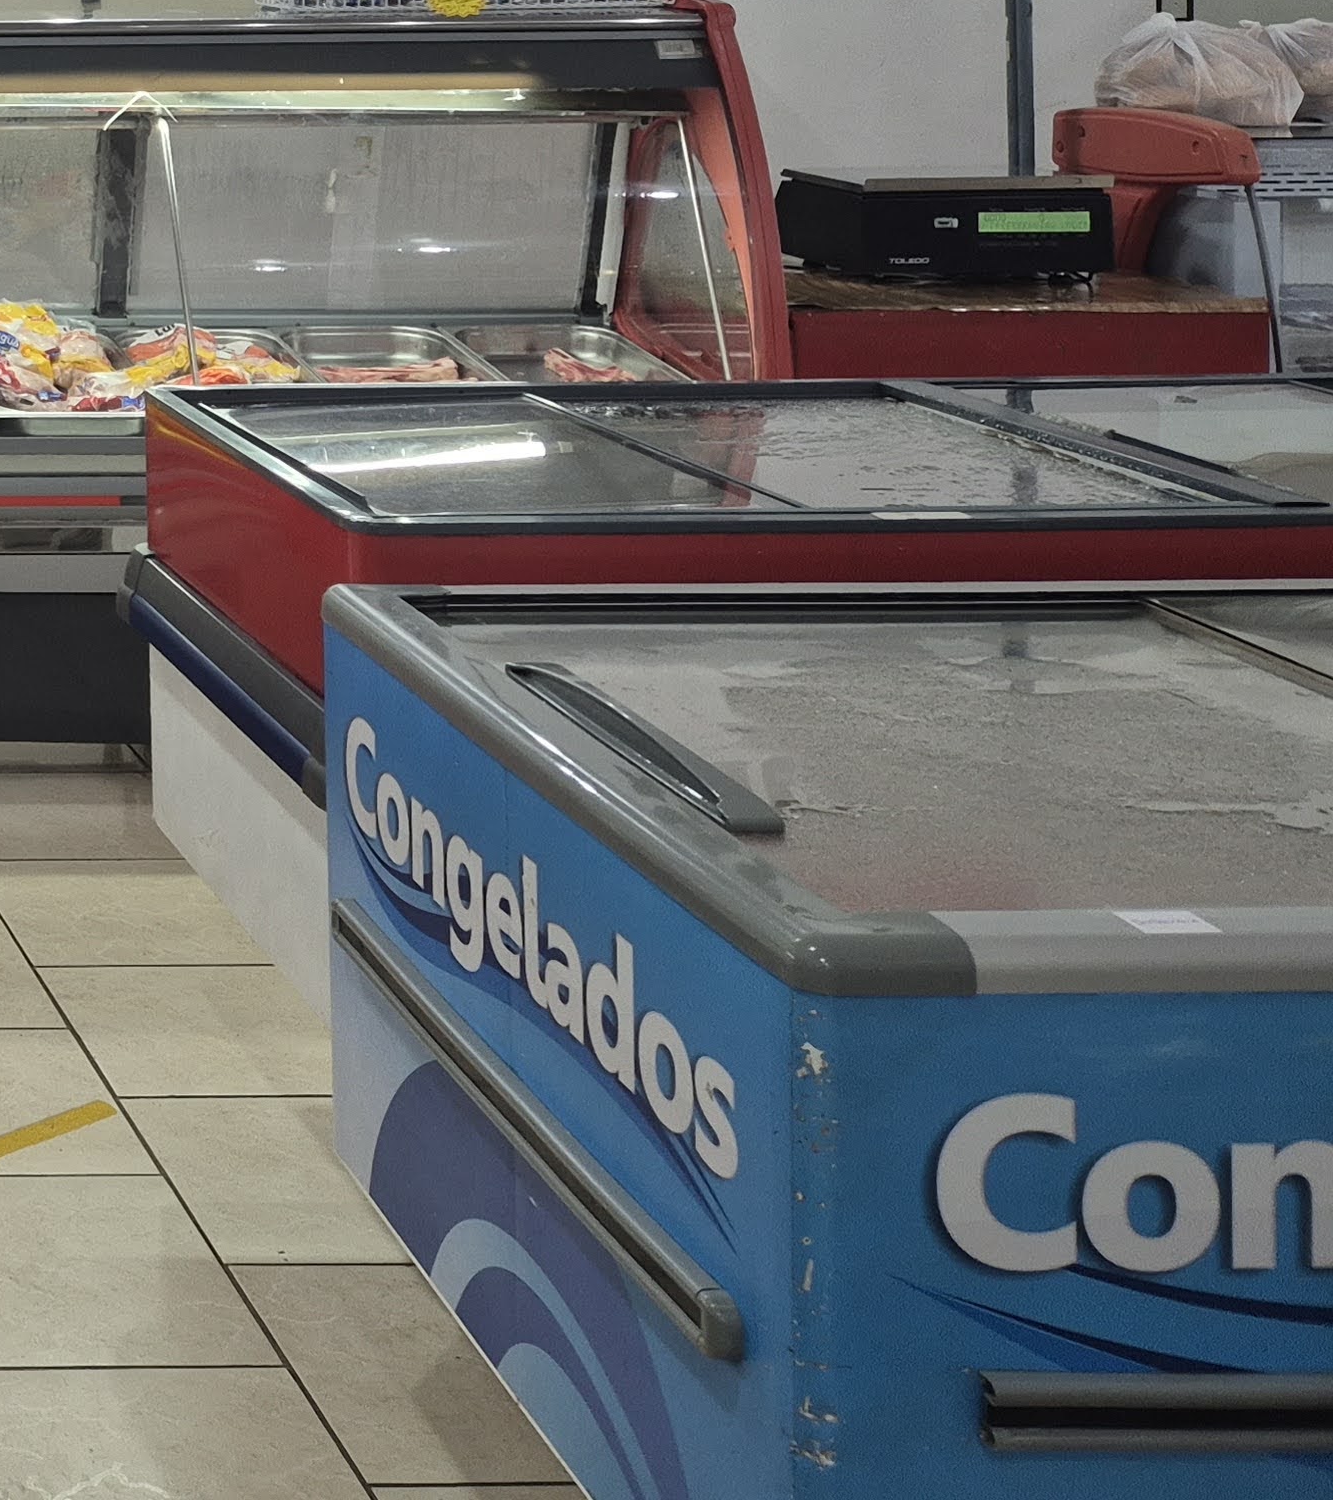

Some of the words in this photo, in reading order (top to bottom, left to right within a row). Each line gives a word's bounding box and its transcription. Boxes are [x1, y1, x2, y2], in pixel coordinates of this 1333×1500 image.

[889, 257, 930, 265] TOLEDO
[344, 716, 739, 1179] Congelados
[935, 1092, 1333, 1272] Con
